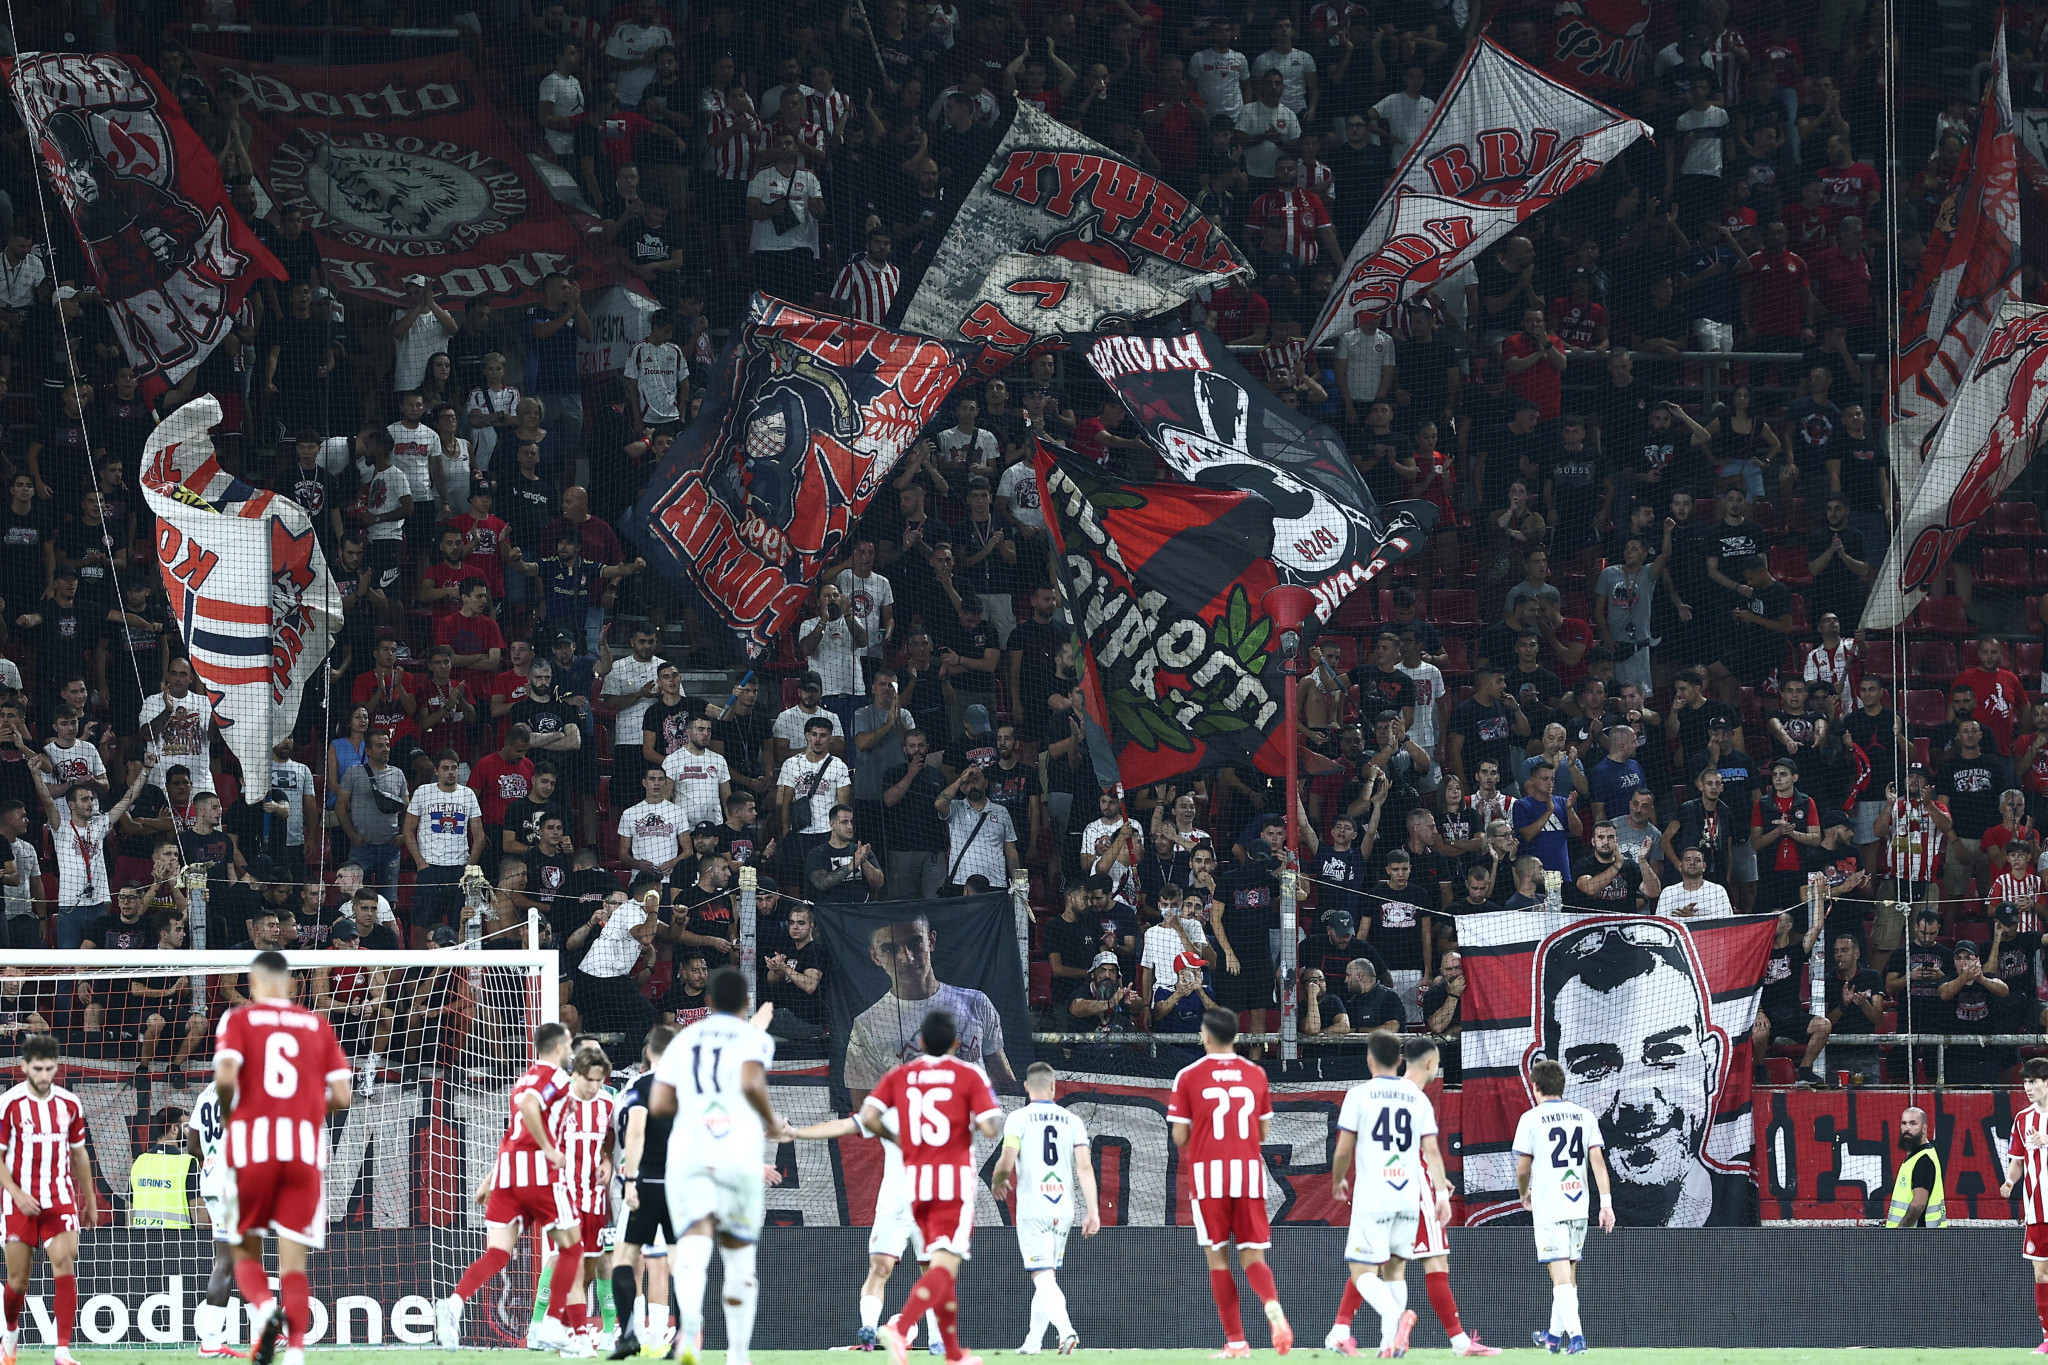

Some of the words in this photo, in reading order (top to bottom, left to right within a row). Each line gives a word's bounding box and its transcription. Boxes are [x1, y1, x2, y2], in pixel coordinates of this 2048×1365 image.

[221, 66, 461, 118] Porto
[362, 131, 493, 170] BORN
[483, 171, 529, 215] RED
[341, 230, 446, 258] SINCE
[449, 216, 508, 251] 1989
[320, 250, 578, 299] Lone
[1556, 466, 1591, 475] GUESS
[263, 1031, 300, 1099] 6
[690, 1045, 723, 1095] 11
[905, 1086, 953, 1147] 15
[1201, 1086, 1256, 1141] 77
[1371, 1106, 1413, 1152] 49
[1042, 1125, 1059, 1167] 6
[1548, 1125, 1586, 1169] 24
